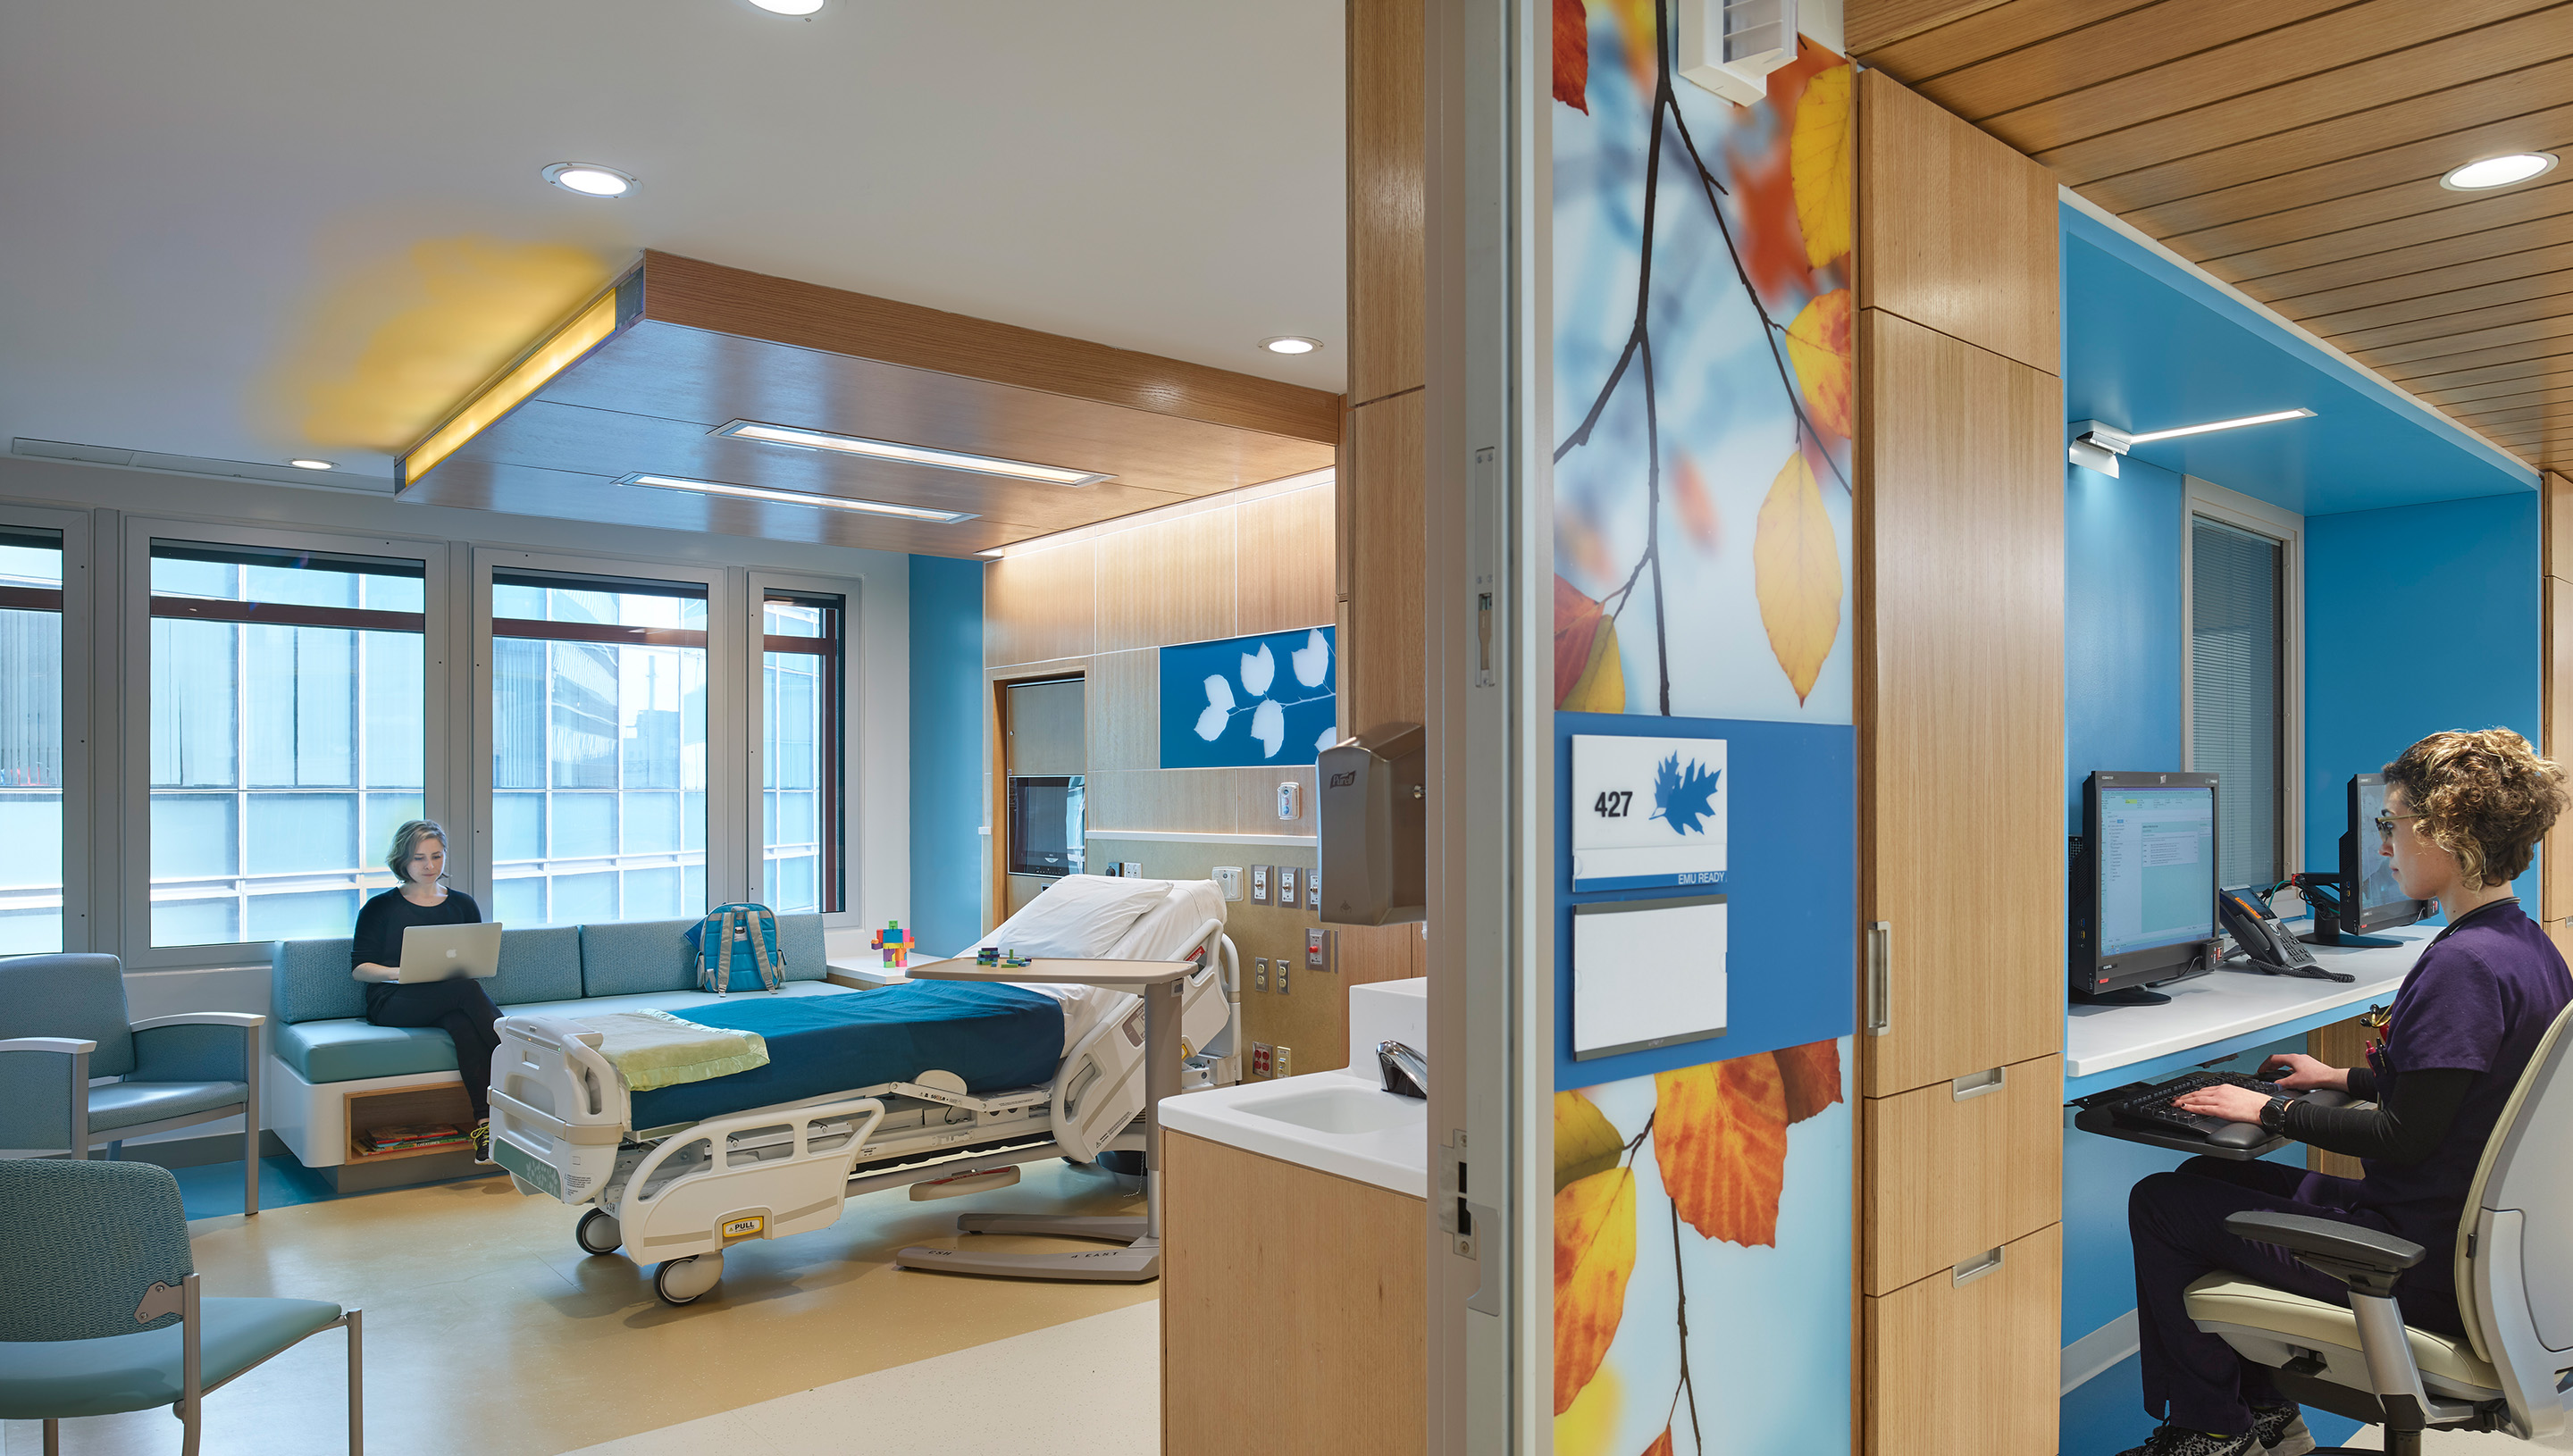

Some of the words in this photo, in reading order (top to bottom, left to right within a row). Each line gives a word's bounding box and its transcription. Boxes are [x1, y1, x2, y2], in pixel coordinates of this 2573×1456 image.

[1594, 791, 1633, 818] 427
[1678, 873, 1697, 885] EMU
[1698, 872, 1725, 884] READY
[734, 1221, 755, 1231] PULL
